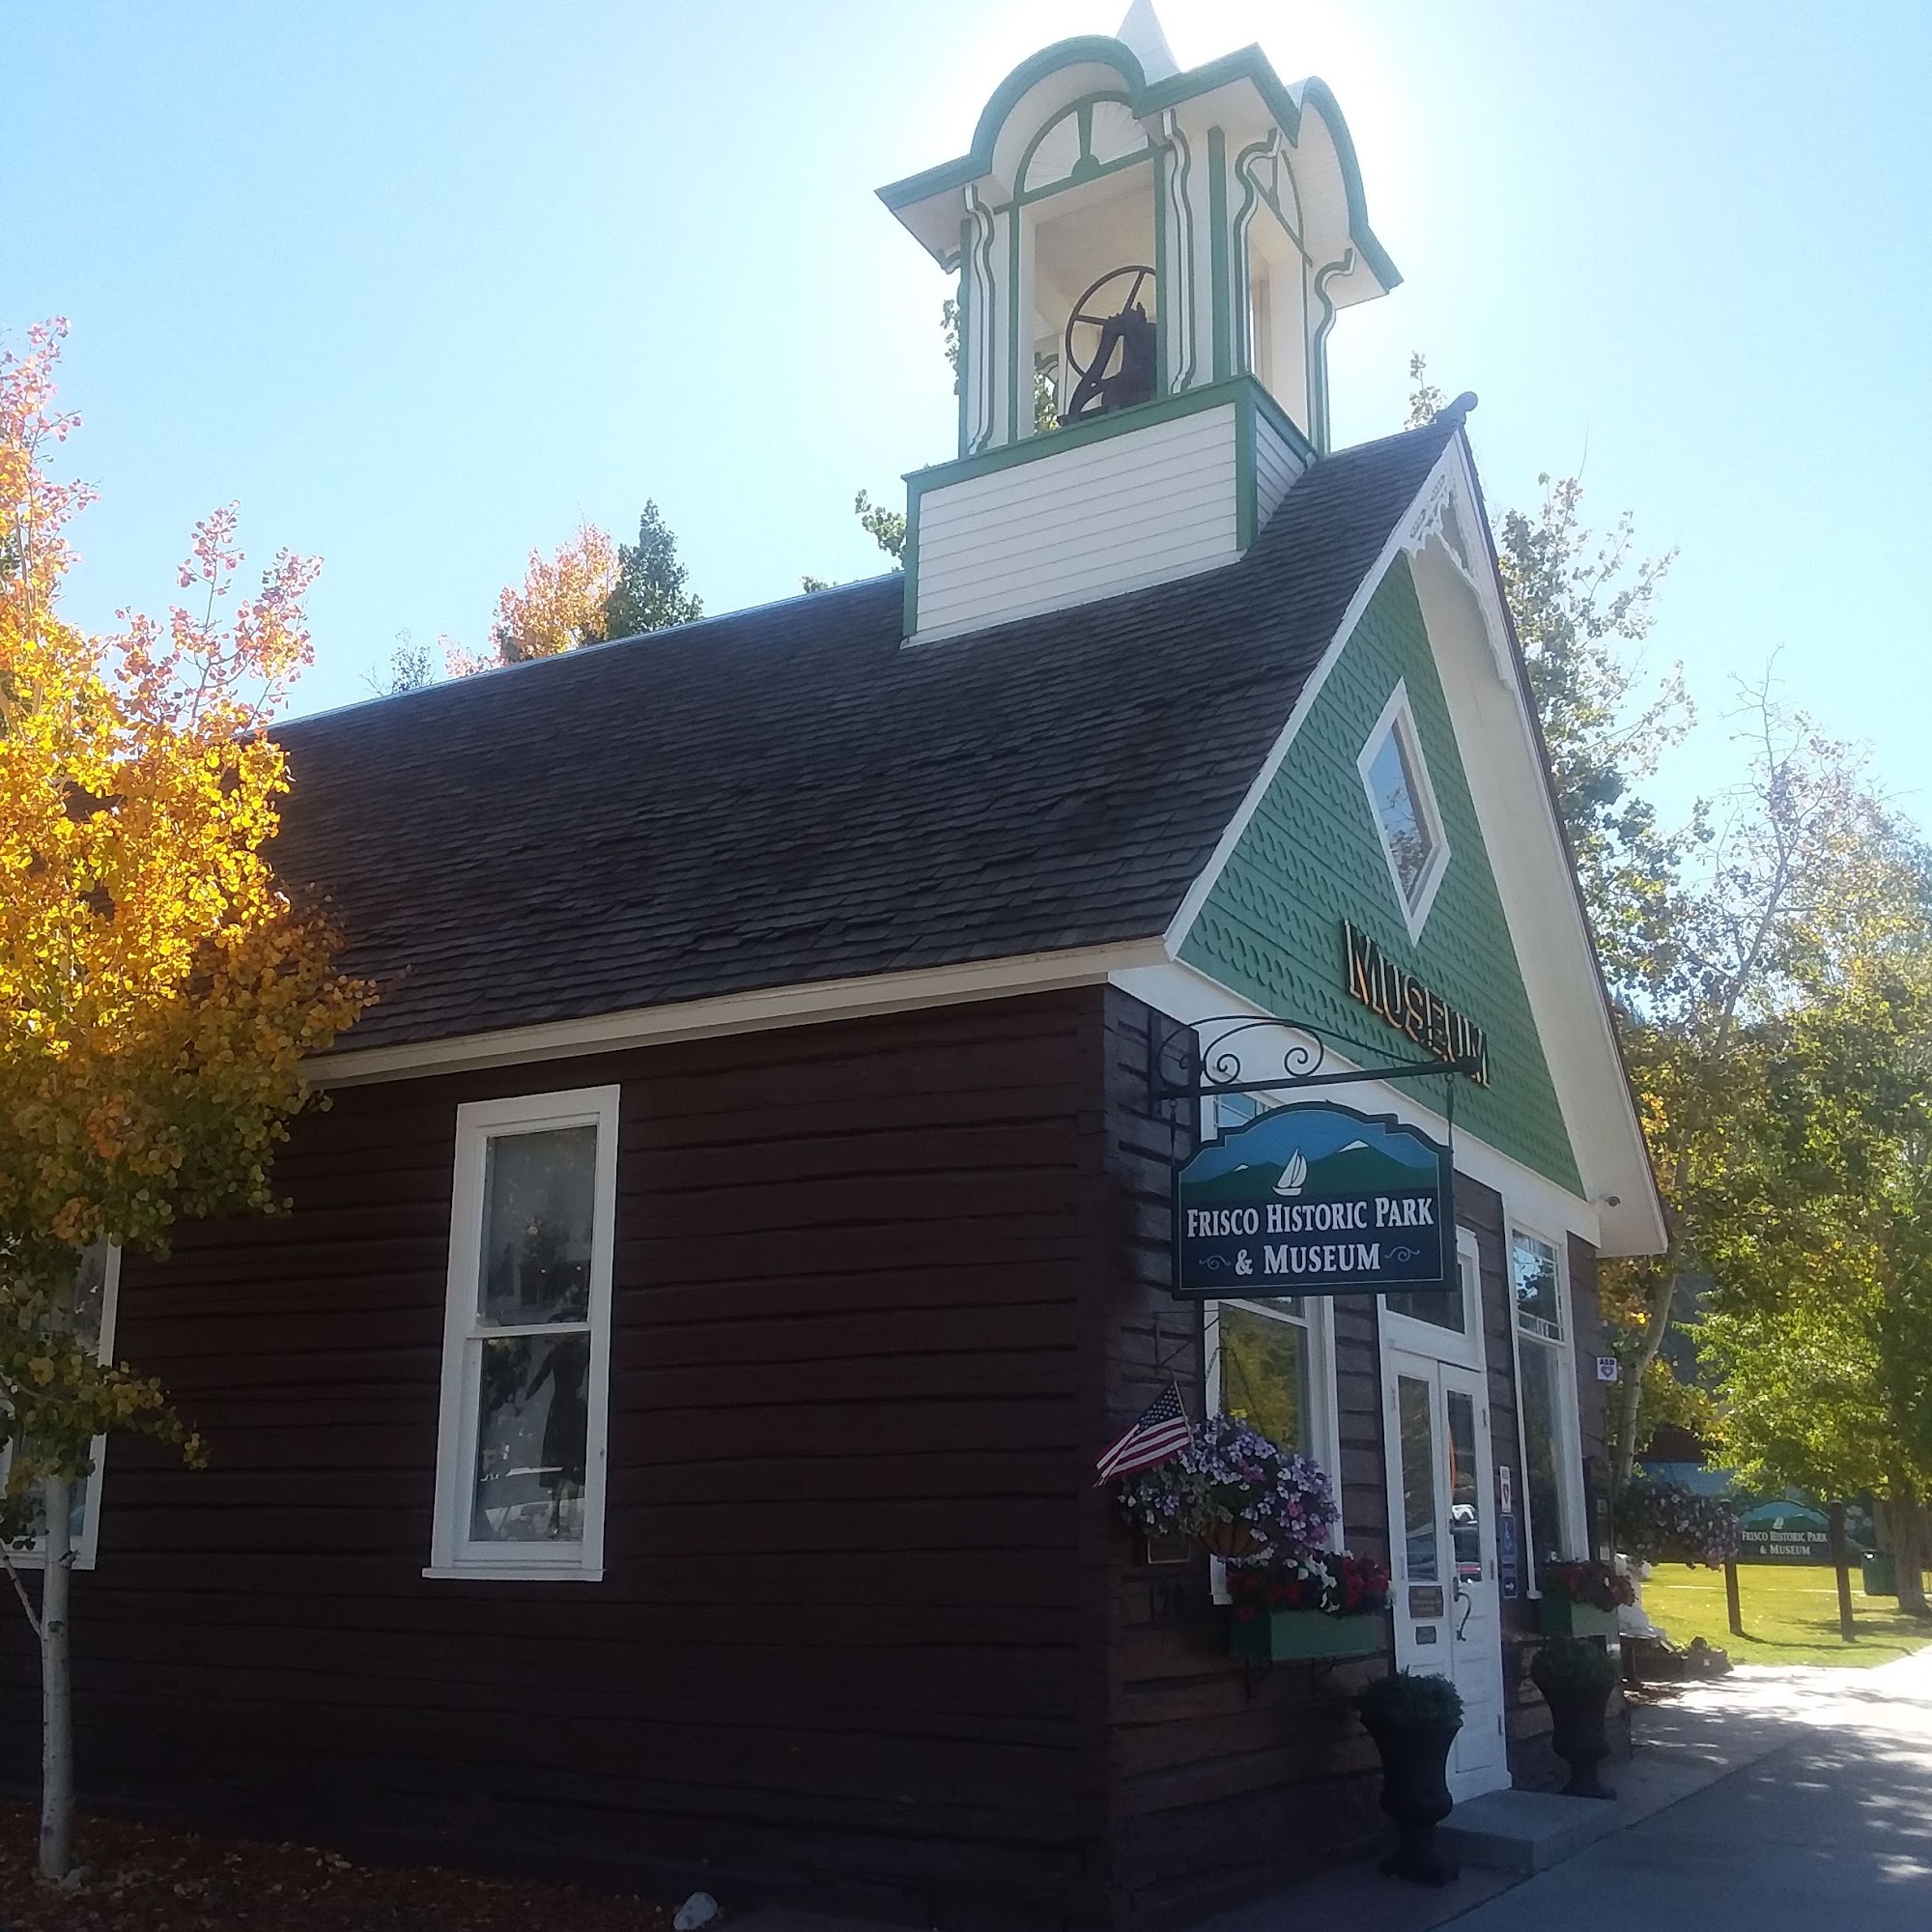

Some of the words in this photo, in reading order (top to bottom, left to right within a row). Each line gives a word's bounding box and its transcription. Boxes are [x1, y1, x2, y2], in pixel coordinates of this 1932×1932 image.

[1344, 919, 1491, 1089] MUSEUM
[1187, 1208, 1259, 1237] FRISCO
[1265, 1201, 1367, 1234] HISTORIC
[1375, 1197, 1434, 1227] PARK
[1235, 1249, 1253, 1275] &
[1264, 1242, 1380, 1274] MUSEUM
[1742, 1531, 1768, 1541] FRISCO
[1770, 1531, 1805, 1542] HISTORIC
[1807, 1531, 1828, 1543] PARK
[1770, 1545, 1810, 1555] MUSEUM
